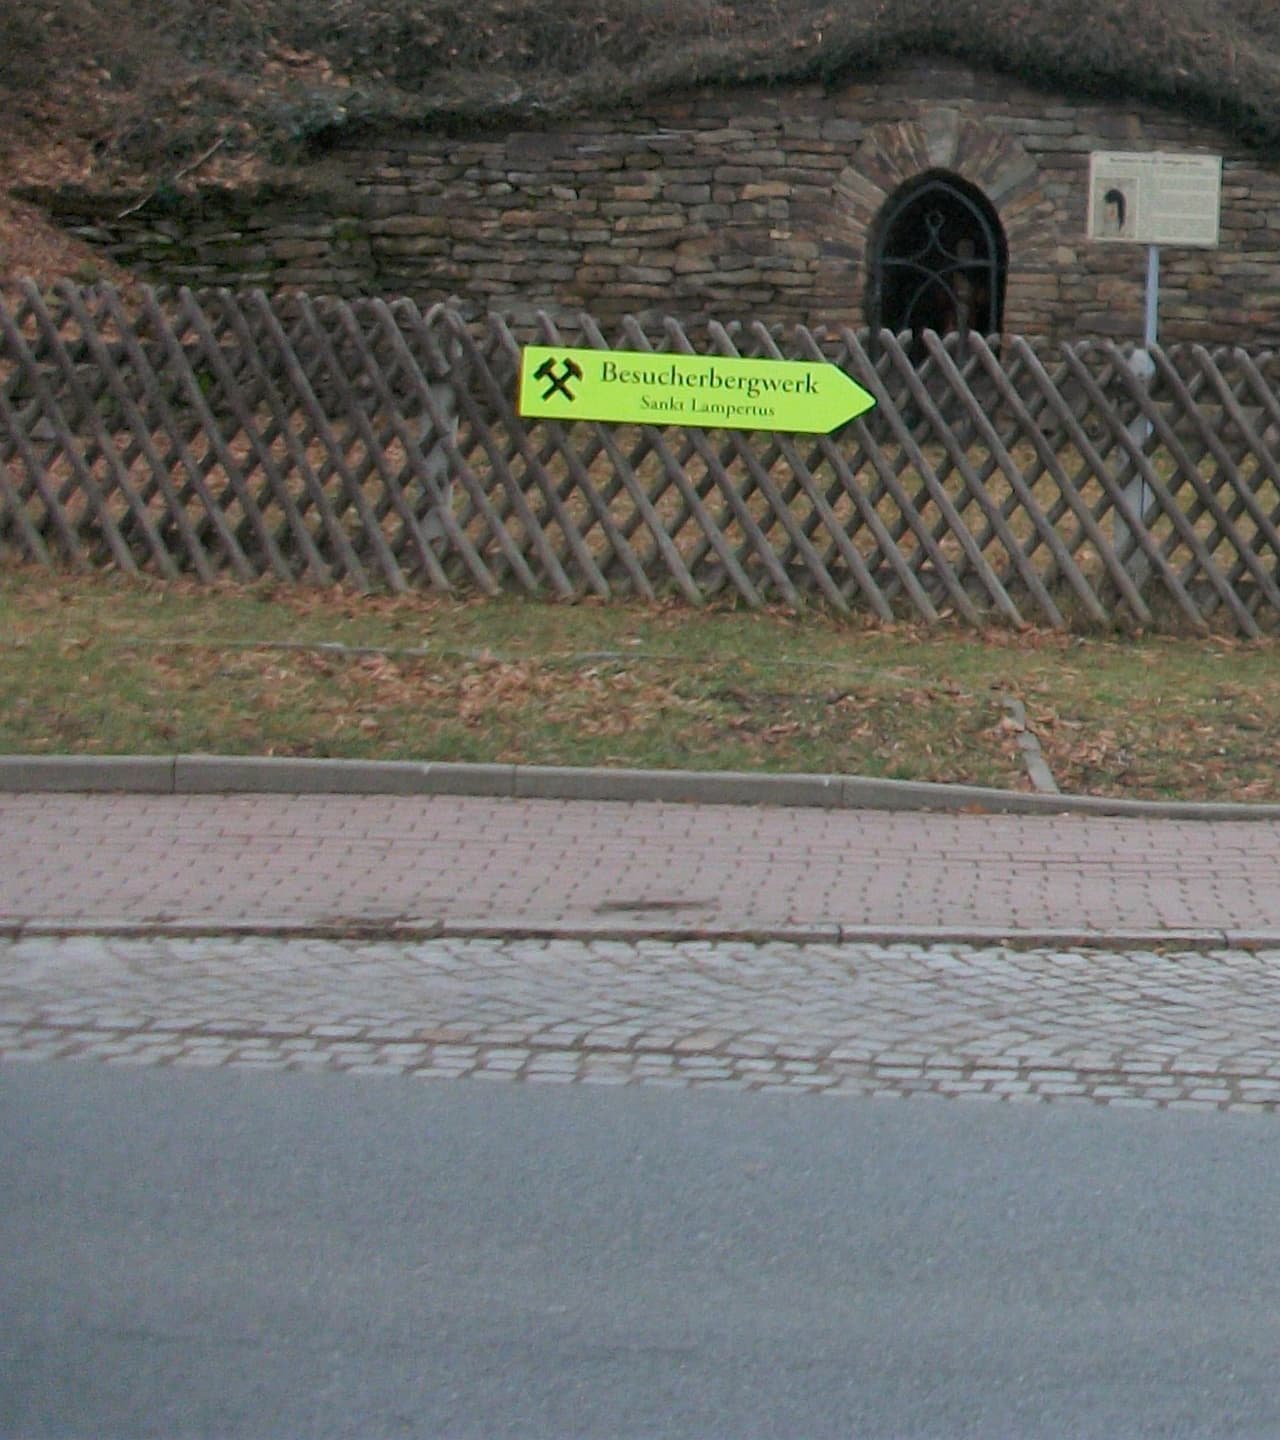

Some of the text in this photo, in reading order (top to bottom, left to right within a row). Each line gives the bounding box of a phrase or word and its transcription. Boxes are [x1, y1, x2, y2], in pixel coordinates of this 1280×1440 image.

[601, 360, 820, 398] Besucherbergwerk
[640, 394, 776, 419] Sankt Lampertus
